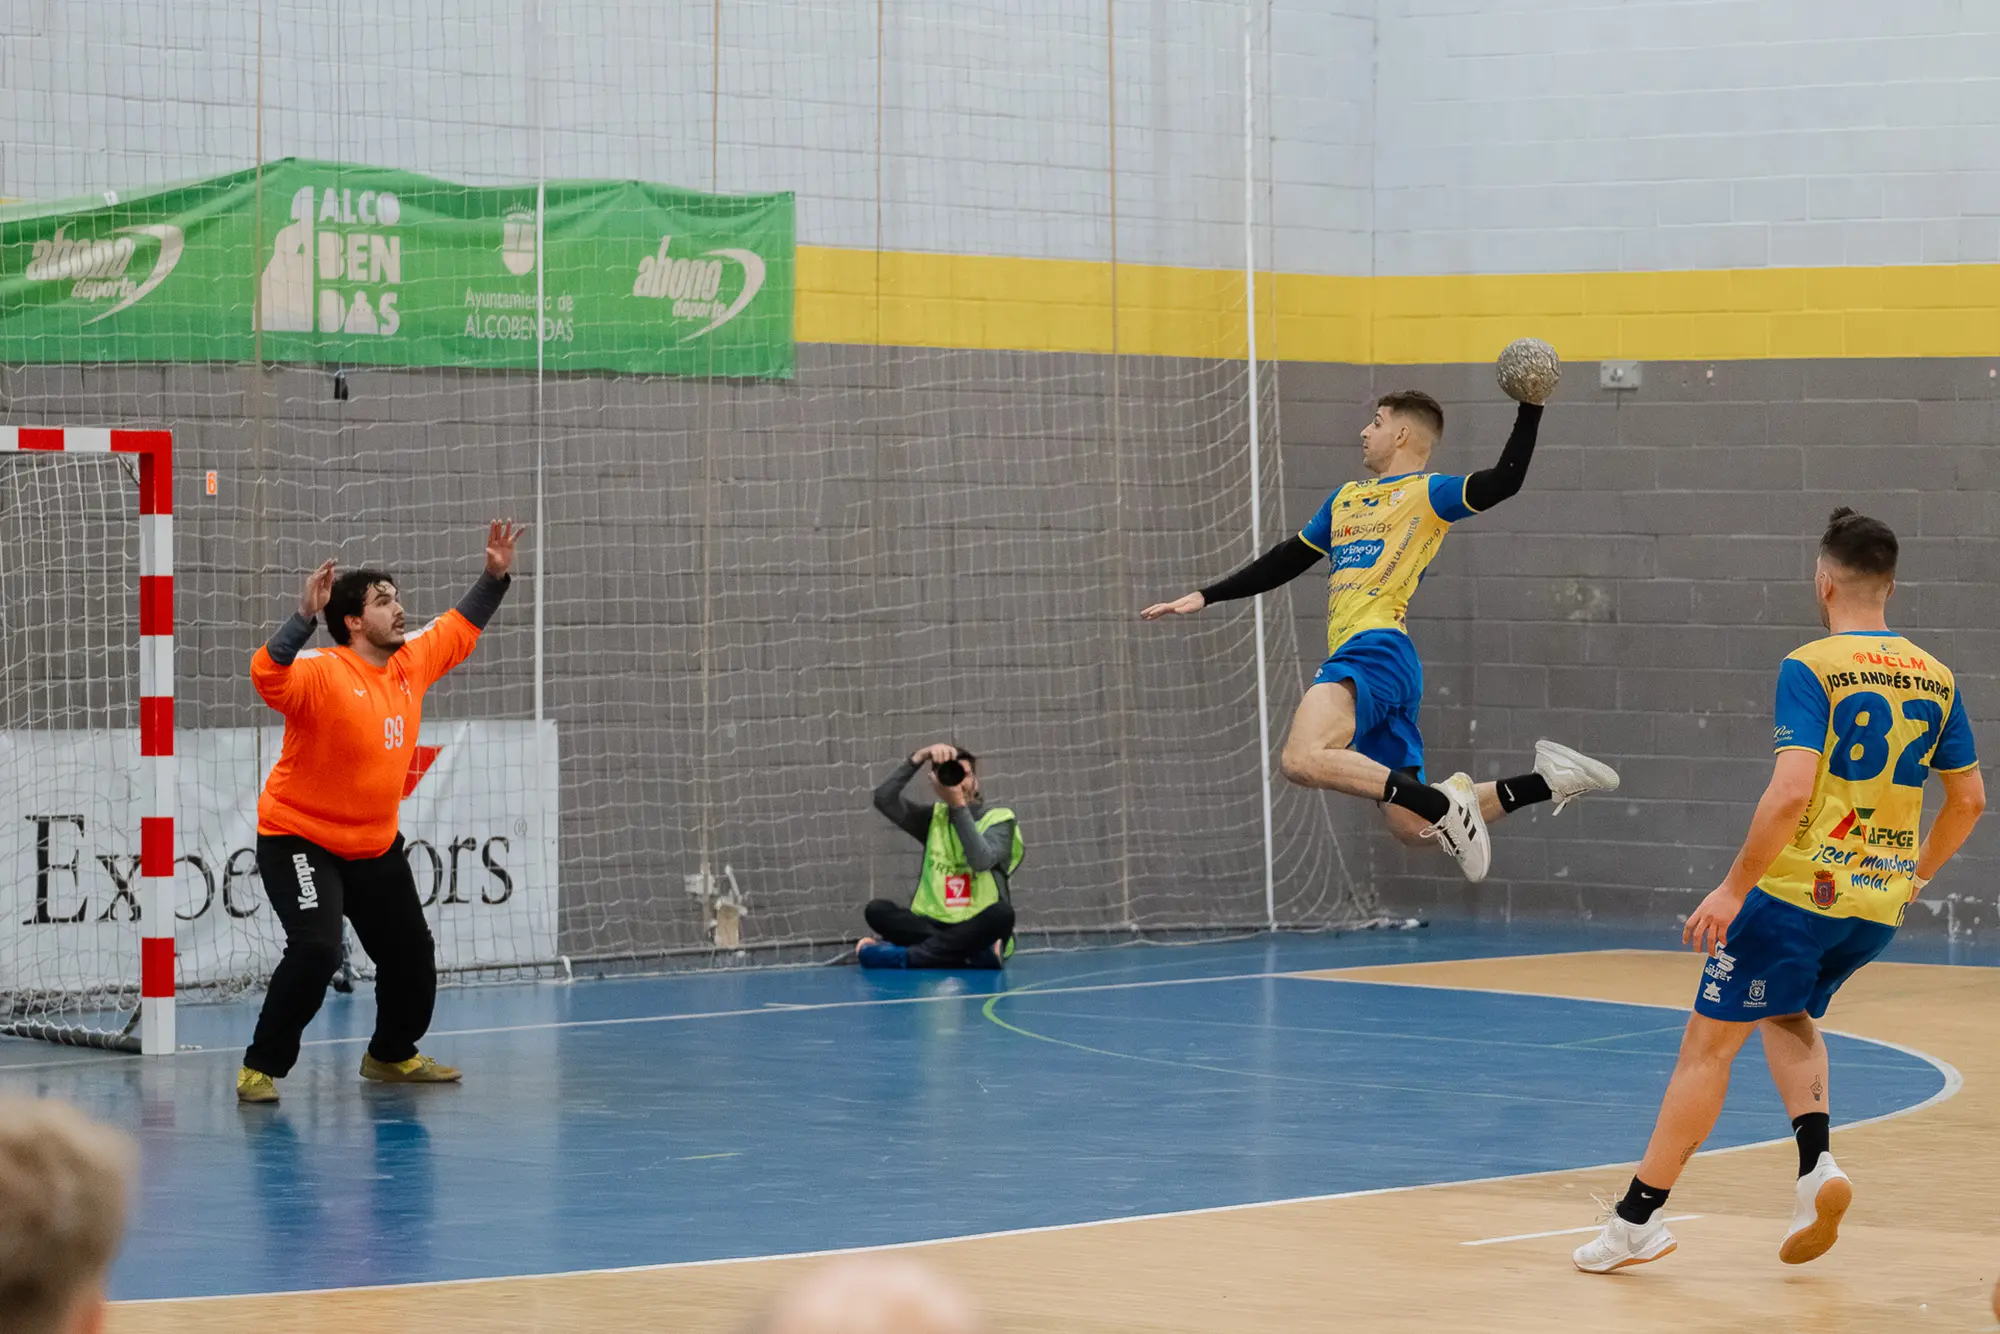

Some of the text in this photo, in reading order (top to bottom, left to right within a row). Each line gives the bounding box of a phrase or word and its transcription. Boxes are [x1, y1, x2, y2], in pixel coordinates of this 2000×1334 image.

[319, 187, 400, 225] ALCO
[318, 231, 401, 283] BEN
[633, 235, 723, 300] abono
[318, 289, 400, 336] DAS
[557, 291, 574, 312] de
[207, 472, 217, 494] 6
[1866, 652, 1927, 672] UCLM
[1826, 671, 1859, 693] JOSE
[1861, 671, 1911, 689] ANDRÉS
[384, 715, 404, 750] 99
[1828, 691, 1943, 788] 82
[292, 853, 319, 910] Kempa
[1851, 873, 1893, 892] mola!
[1860, 854, 1918, 880] mancheg
